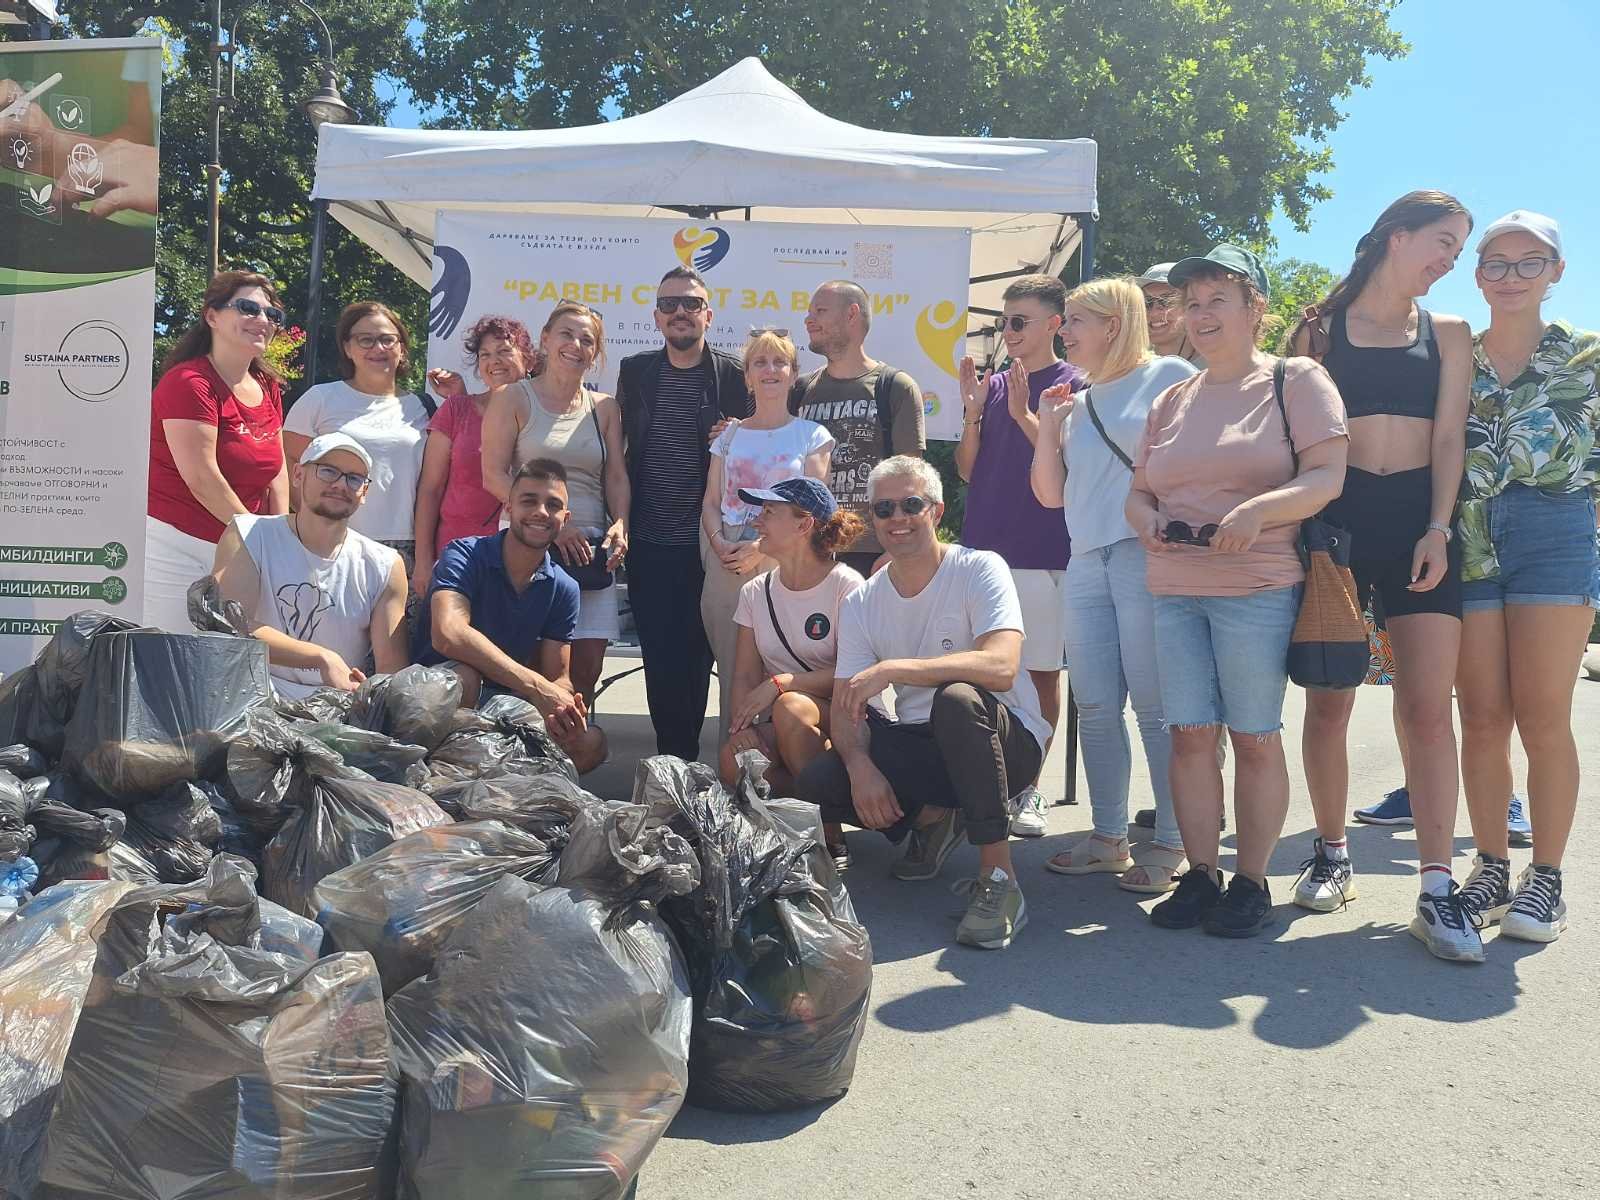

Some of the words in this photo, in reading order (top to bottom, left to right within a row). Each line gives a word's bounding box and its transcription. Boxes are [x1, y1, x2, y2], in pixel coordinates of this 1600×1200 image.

[740, 289, 781, 310] ЗА
[717, 327, 734, 335] НА
[24, 354, 70, 362] SUSTAINA
[72, 355, 120, 363] PARTNERS
[9, 466, 82, 475] ВЪЗМОЖНОСТИ
[44, 480, 100, 488] ОТГОВОРНИ
[3, 505, 54, 514] ПО-ЗЕЛЕНА
[11, 621, 62, 635] ПРАКТ
